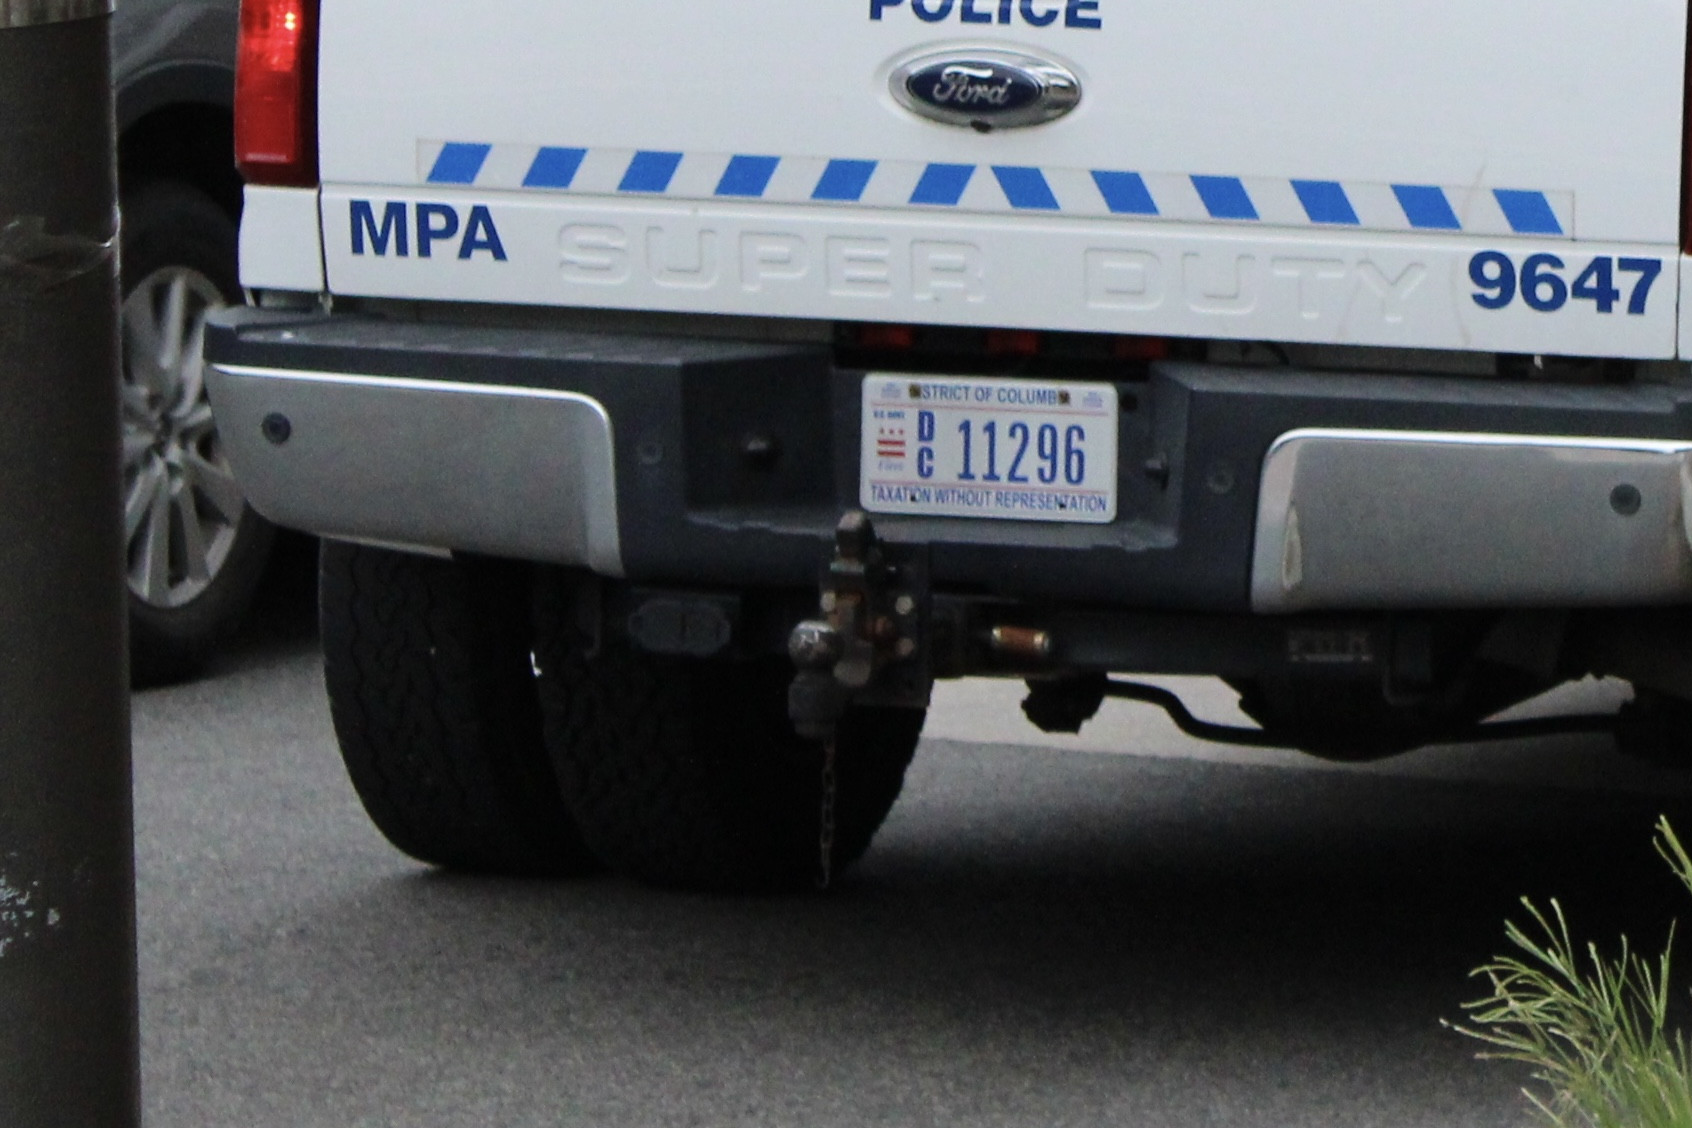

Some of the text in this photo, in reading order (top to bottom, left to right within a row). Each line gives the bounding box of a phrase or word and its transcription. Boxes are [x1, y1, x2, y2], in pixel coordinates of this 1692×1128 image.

[933, 66, 1012, 103] Ford
[349, 200, 508, 261] MPA
[556, 222, 1427, 323] SUPER DUTY
[1468, 250, 1662, 315] 9647
[909, 384, 1071, 405] STRICT OF COLUMB
[957, 418, 1086, 486] 11296
[870, 485, 1107, 512] TAXATION WITHOUT REPRESENTATION
